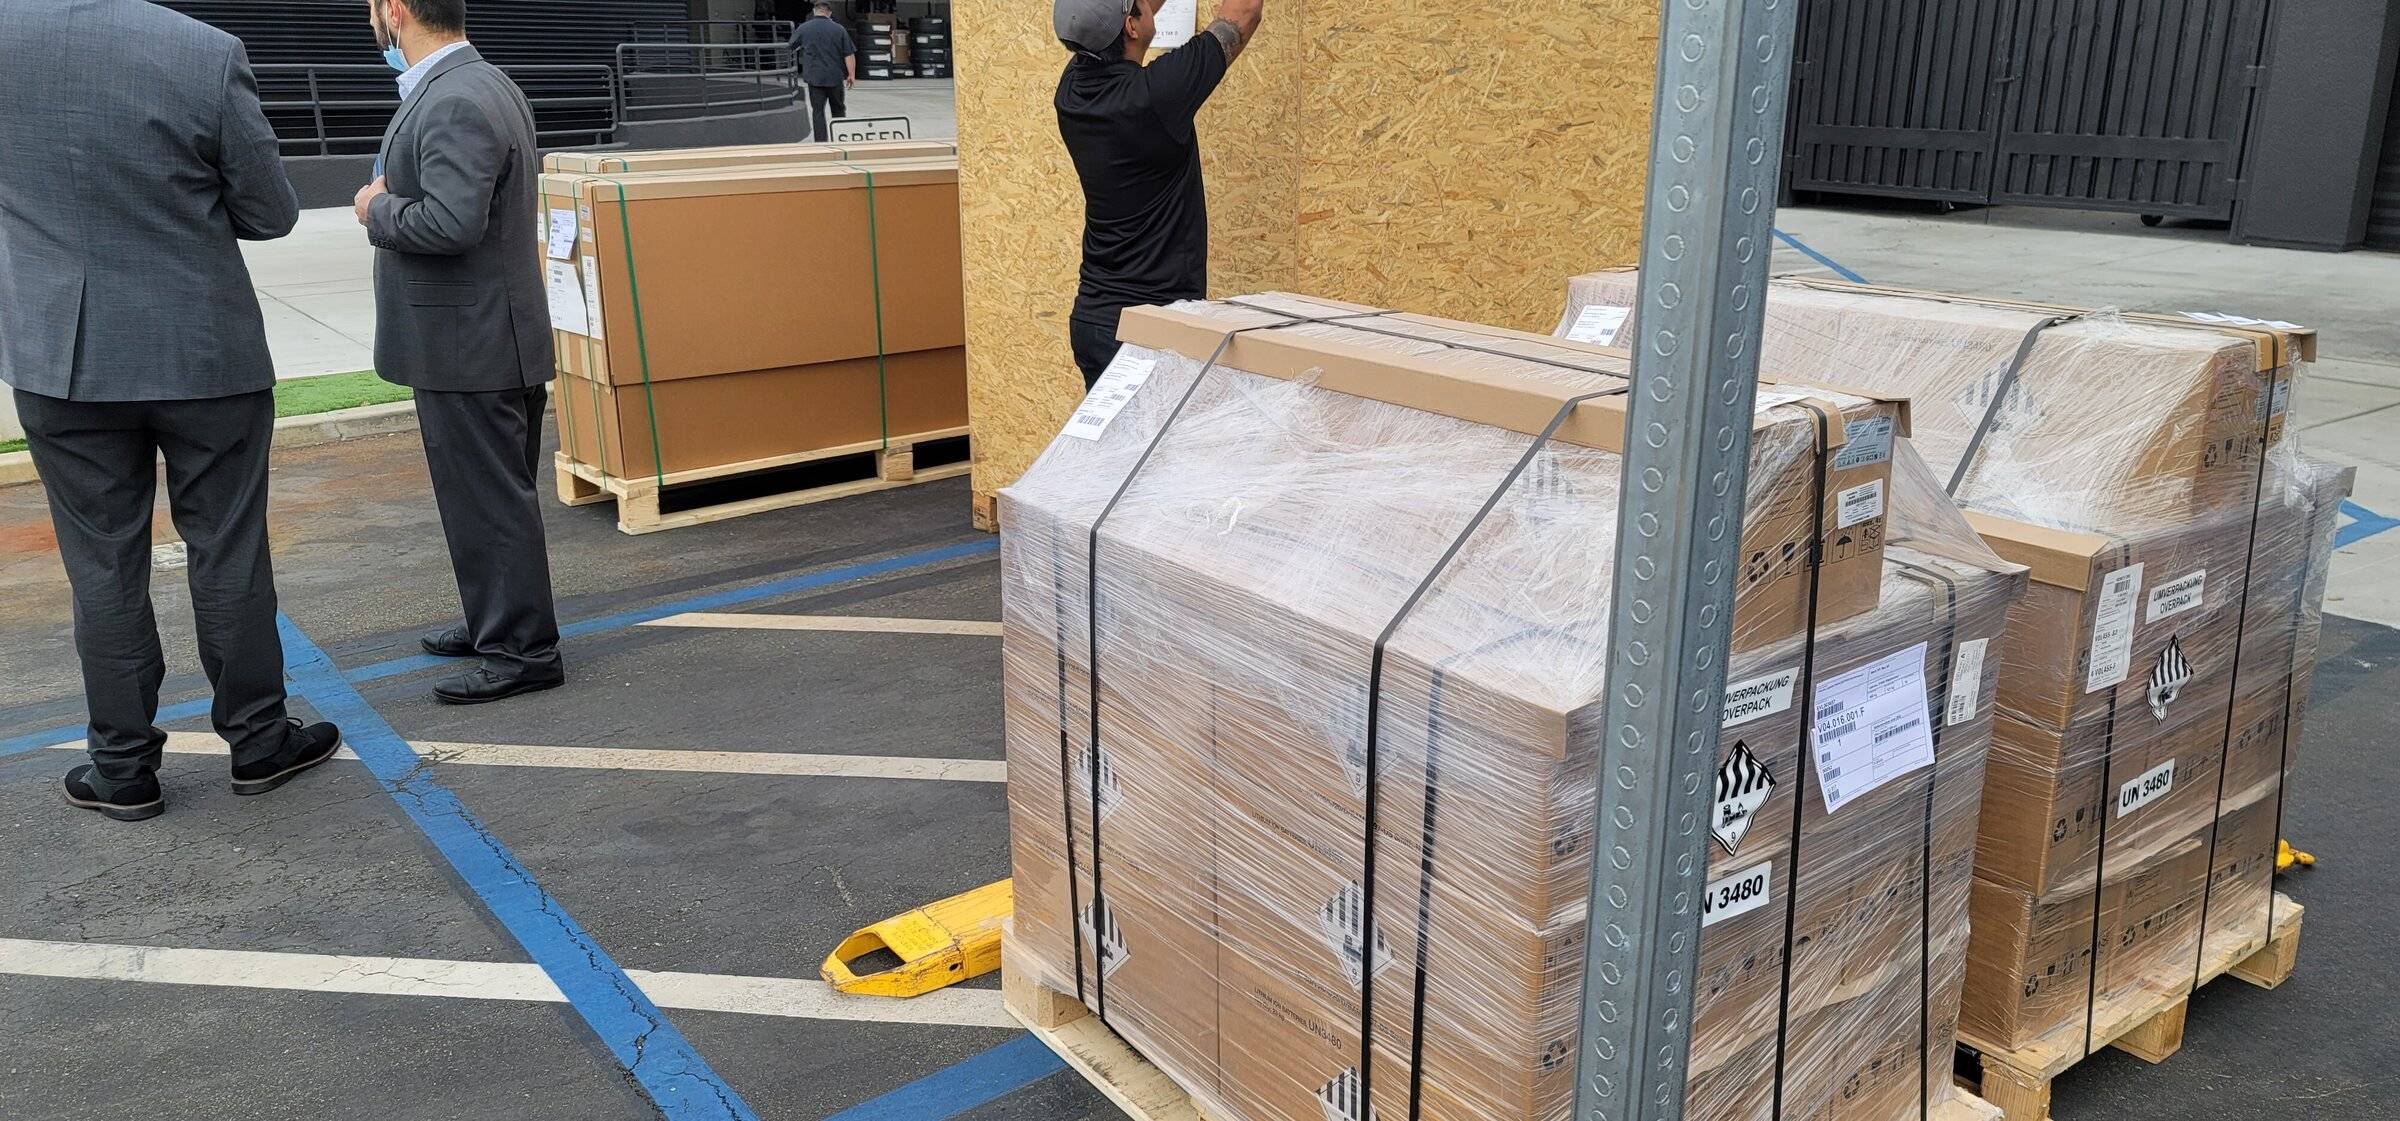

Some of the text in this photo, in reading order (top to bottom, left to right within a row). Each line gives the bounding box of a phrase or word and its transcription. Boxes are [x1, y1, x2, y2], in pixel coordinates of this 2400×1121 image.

[2153, 574, 2203, 602] UMVERPACKUNG
[2160, 593, 2192, 614] OVERPACK
[1725, 675, 1790, 704] VERPACKUNG
[1722, 696, 1772, 722] OVERPACK
[2122, 769, 2170, 808] UN 3480
[1703, 874, 1764, 914] N 3480
